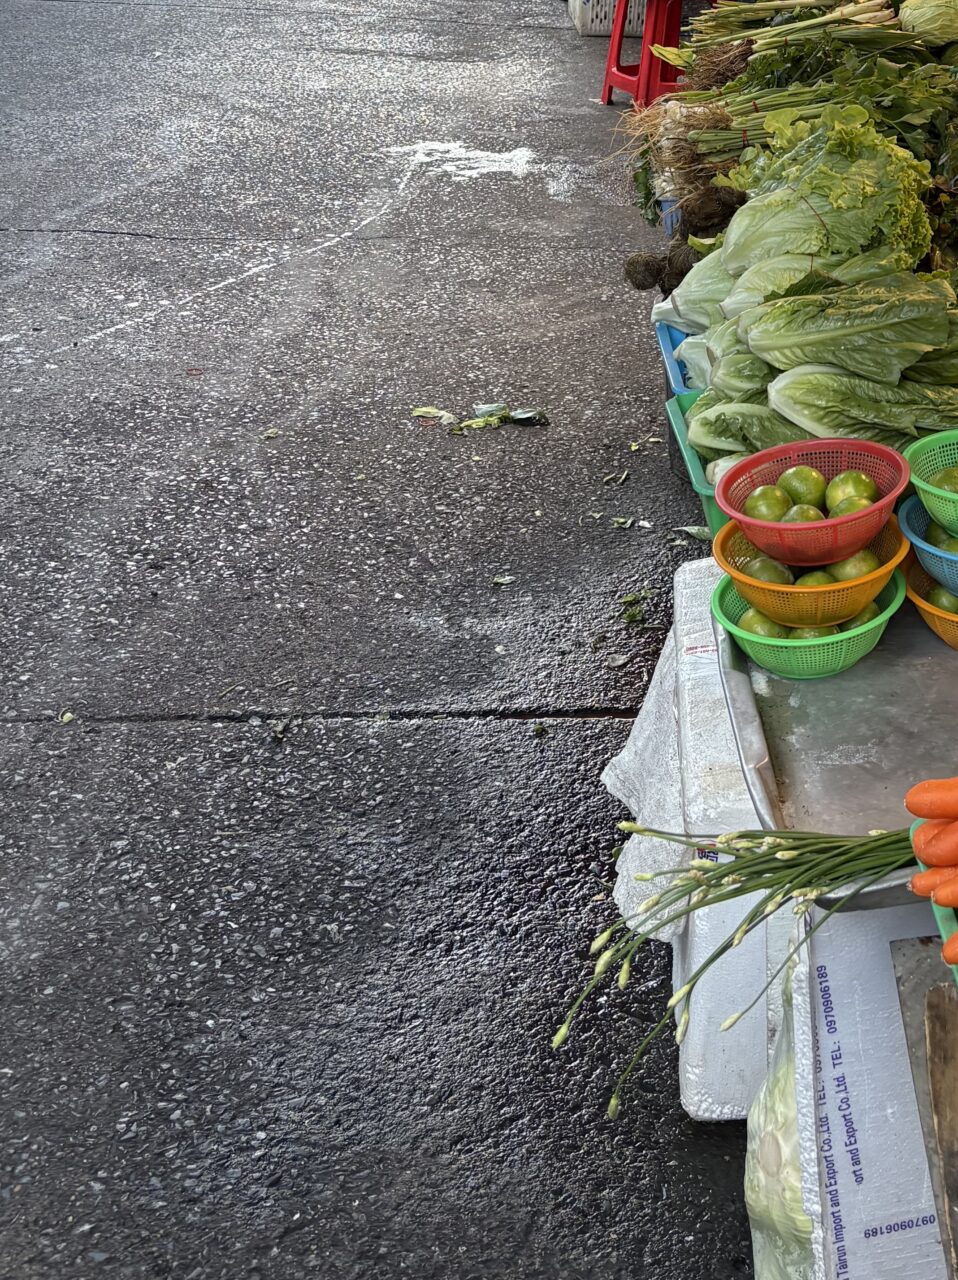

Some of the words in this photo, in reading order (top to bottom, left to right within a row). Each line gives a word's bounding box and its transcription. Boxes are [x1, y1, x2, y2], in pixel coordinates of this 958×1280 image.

[816, 965, 838, 1034] 0970906189
[830, 1040, 843, 1070] TEL:
[841, 1112, 858, 1148] Export
[824, 1154, 839, 1189] Export
[846, 1147, 861, 1167] and
[851, 1168, 864, 1187] ort
[826, 1189, 840, 1208] and
[830, 1209, 846, 1245] Import
[864, 1214, 936, 1239] 0970906189
[836, 1244, 849, 1279] Tairun
